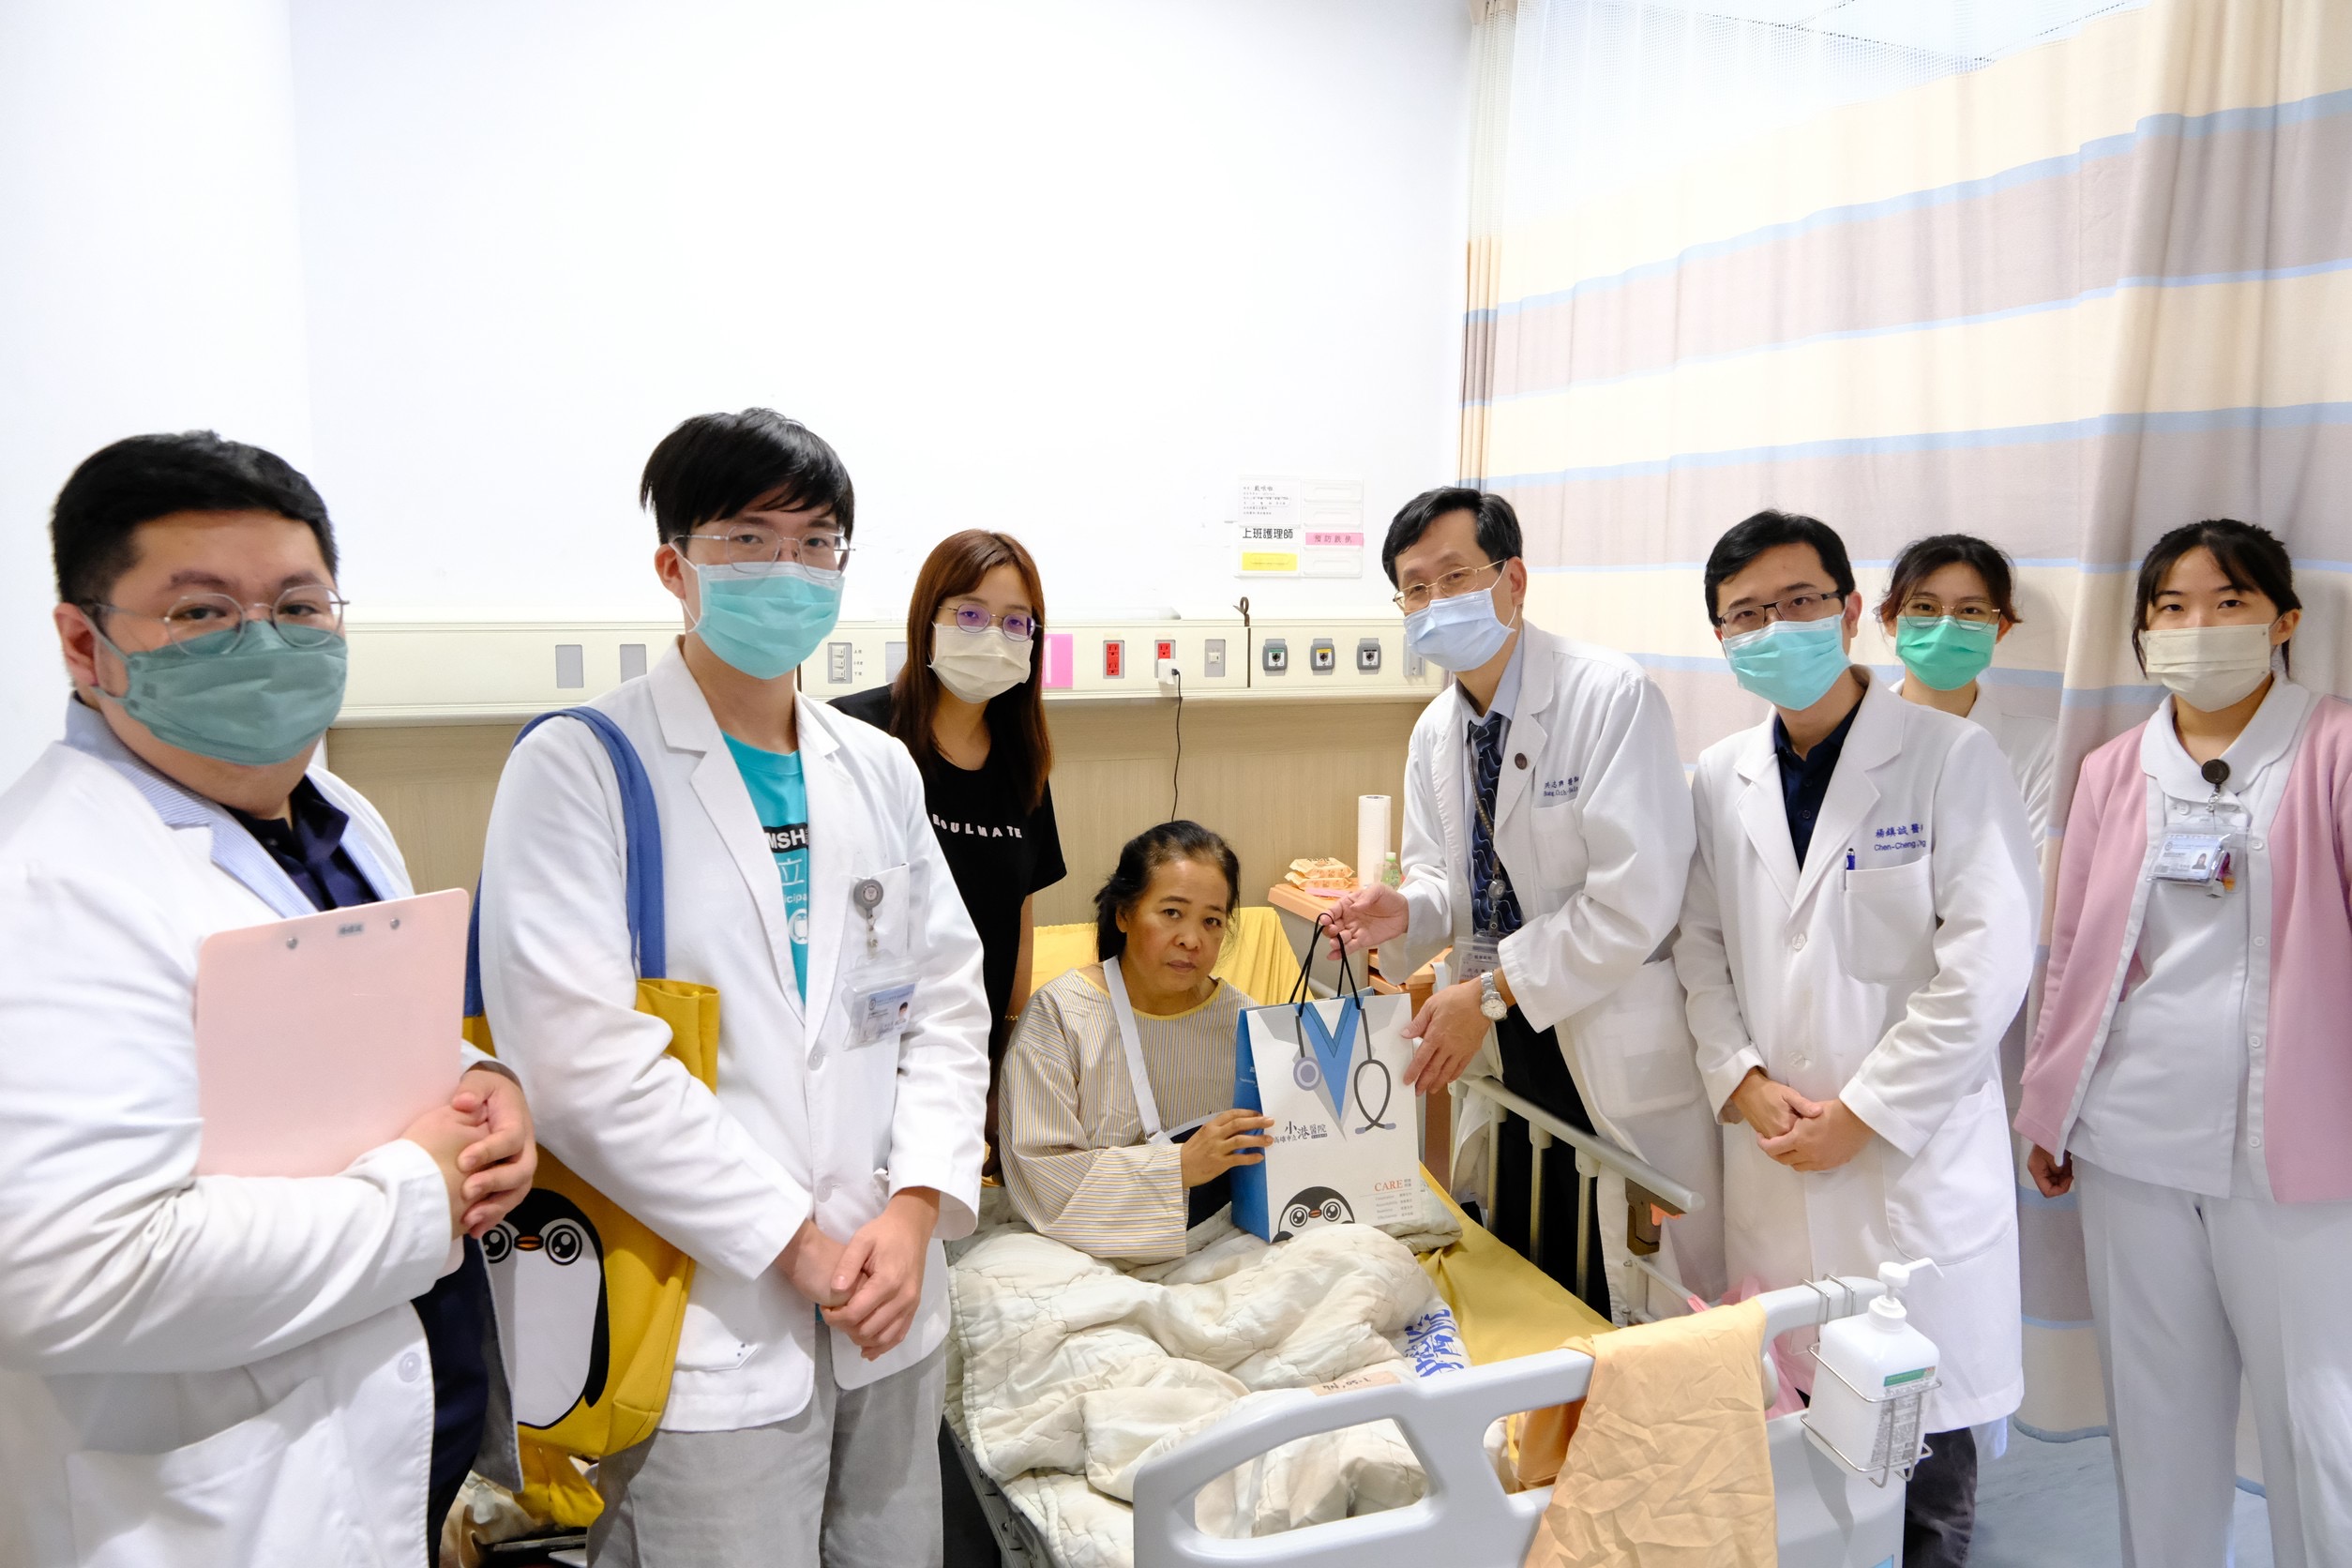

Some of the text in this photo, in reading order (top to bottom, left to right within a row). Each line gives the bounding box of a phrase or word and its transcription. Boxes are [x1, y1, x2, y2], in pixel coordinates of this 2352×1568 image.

[1243, 528, 1293, 539] 上班護理師
[1374, 1180, 1404, 1192] CARE
